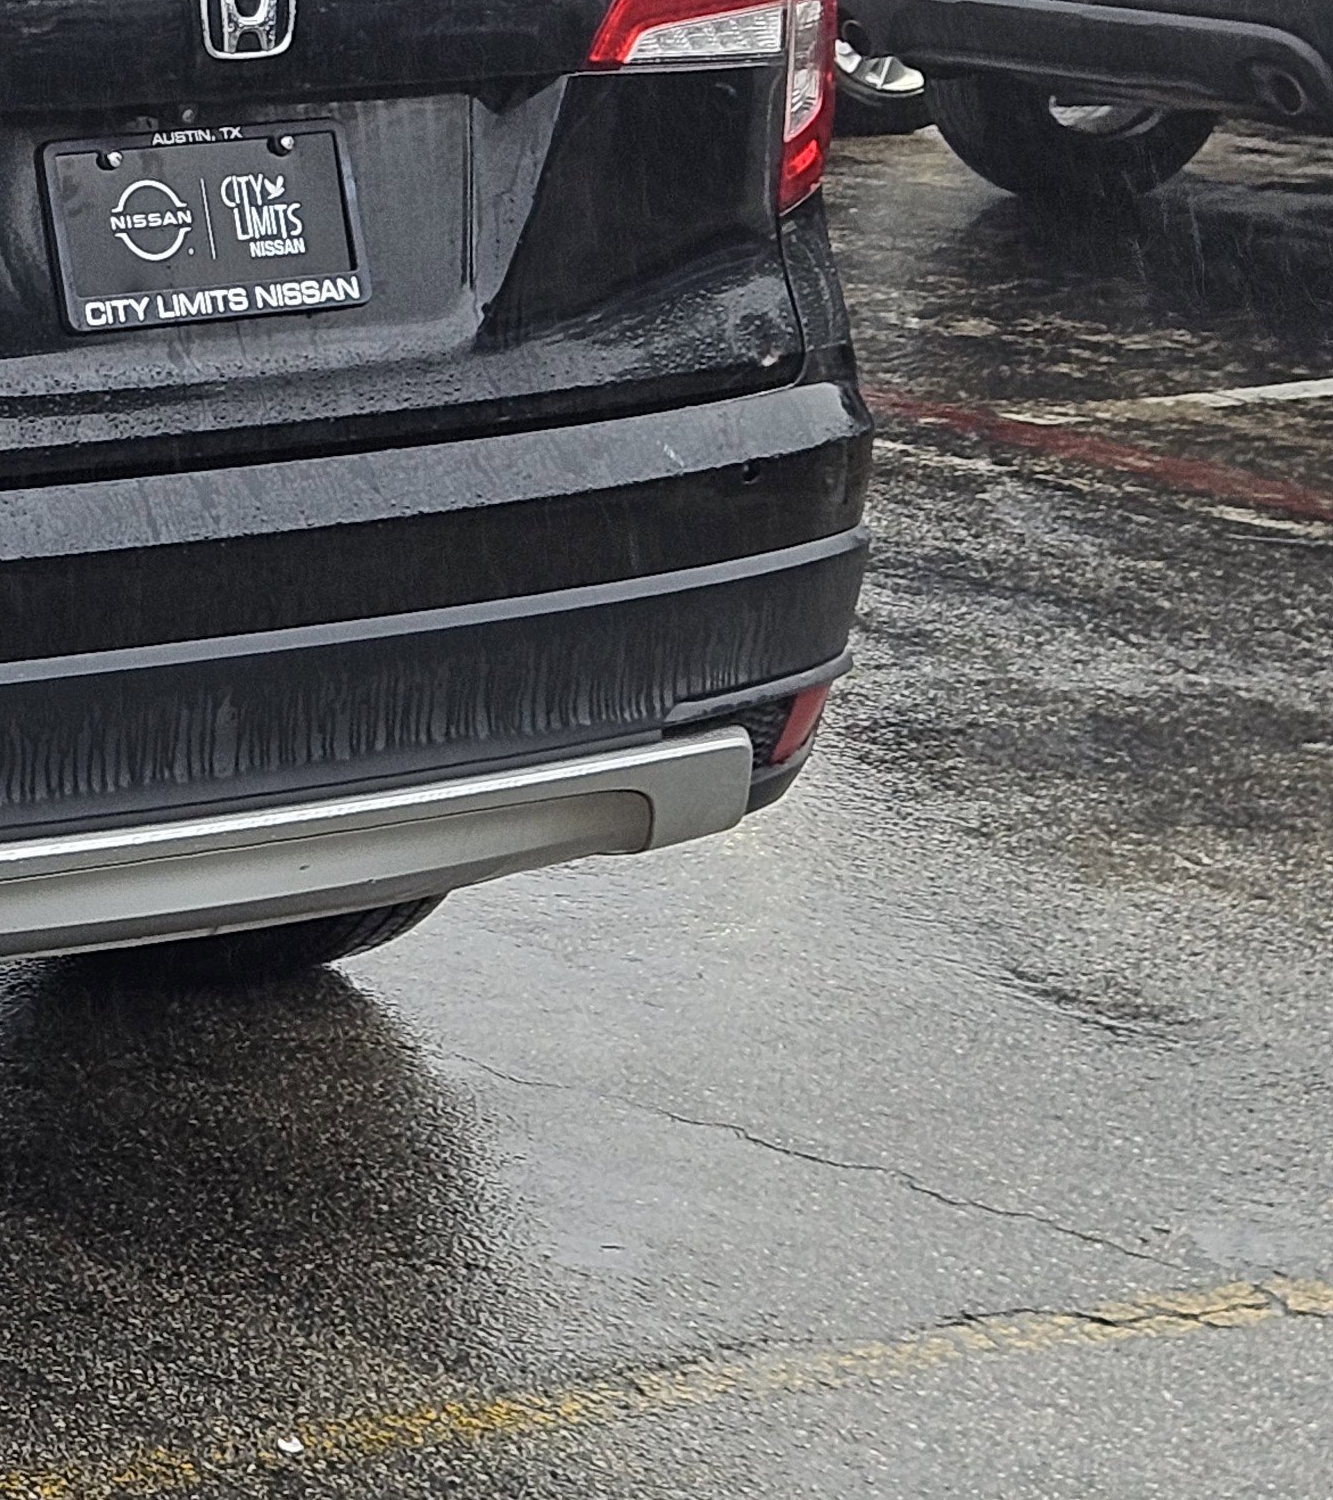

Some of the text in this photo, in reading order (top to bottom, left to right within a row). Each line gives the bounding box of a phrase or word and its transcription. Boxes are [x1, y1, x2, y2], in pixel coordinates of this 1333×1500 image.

[151, 126, 244, 146] AUSTIN, TX
[220, 173, 264, 208] CITY
[109, 209, 193, 231] NISSAN
[232, 202, 303, 242] LIMITS
[249, 237, 306, 258] NISSAN
[84, 275, 361, 327] CITY LIMITS NISSAN
